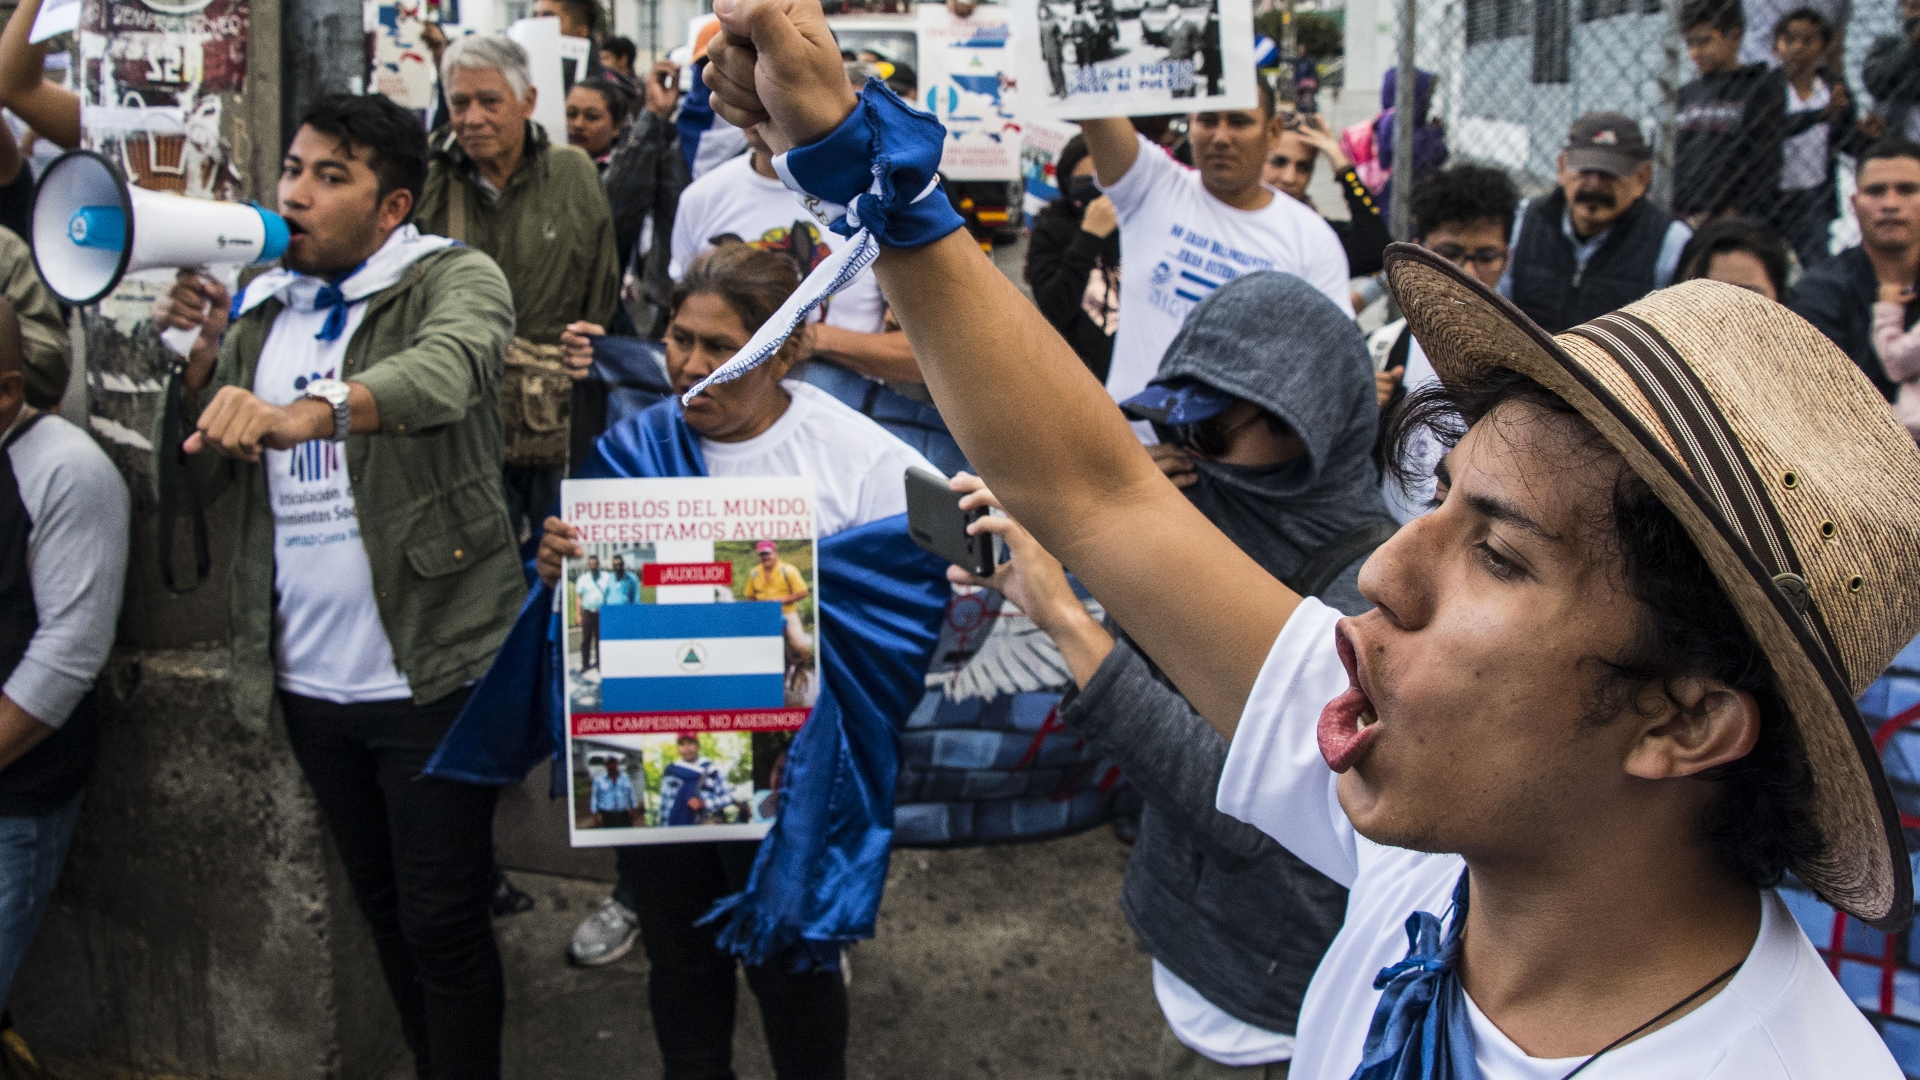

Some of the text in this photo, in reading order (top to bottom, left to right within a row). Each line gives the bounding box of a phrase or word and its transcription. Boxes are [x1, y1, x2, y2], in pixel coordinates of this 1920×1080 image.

[568, 497, 812, 522] ¡PUEBLOS DEL MUNDO,
[731, 519, 812, 540] AYUDA!
[660, 566, 726, 584] ¡AUXILIO!
[577, 711, 806, 735] ¡SON CAMPESINOS, NO ASESINOS!
